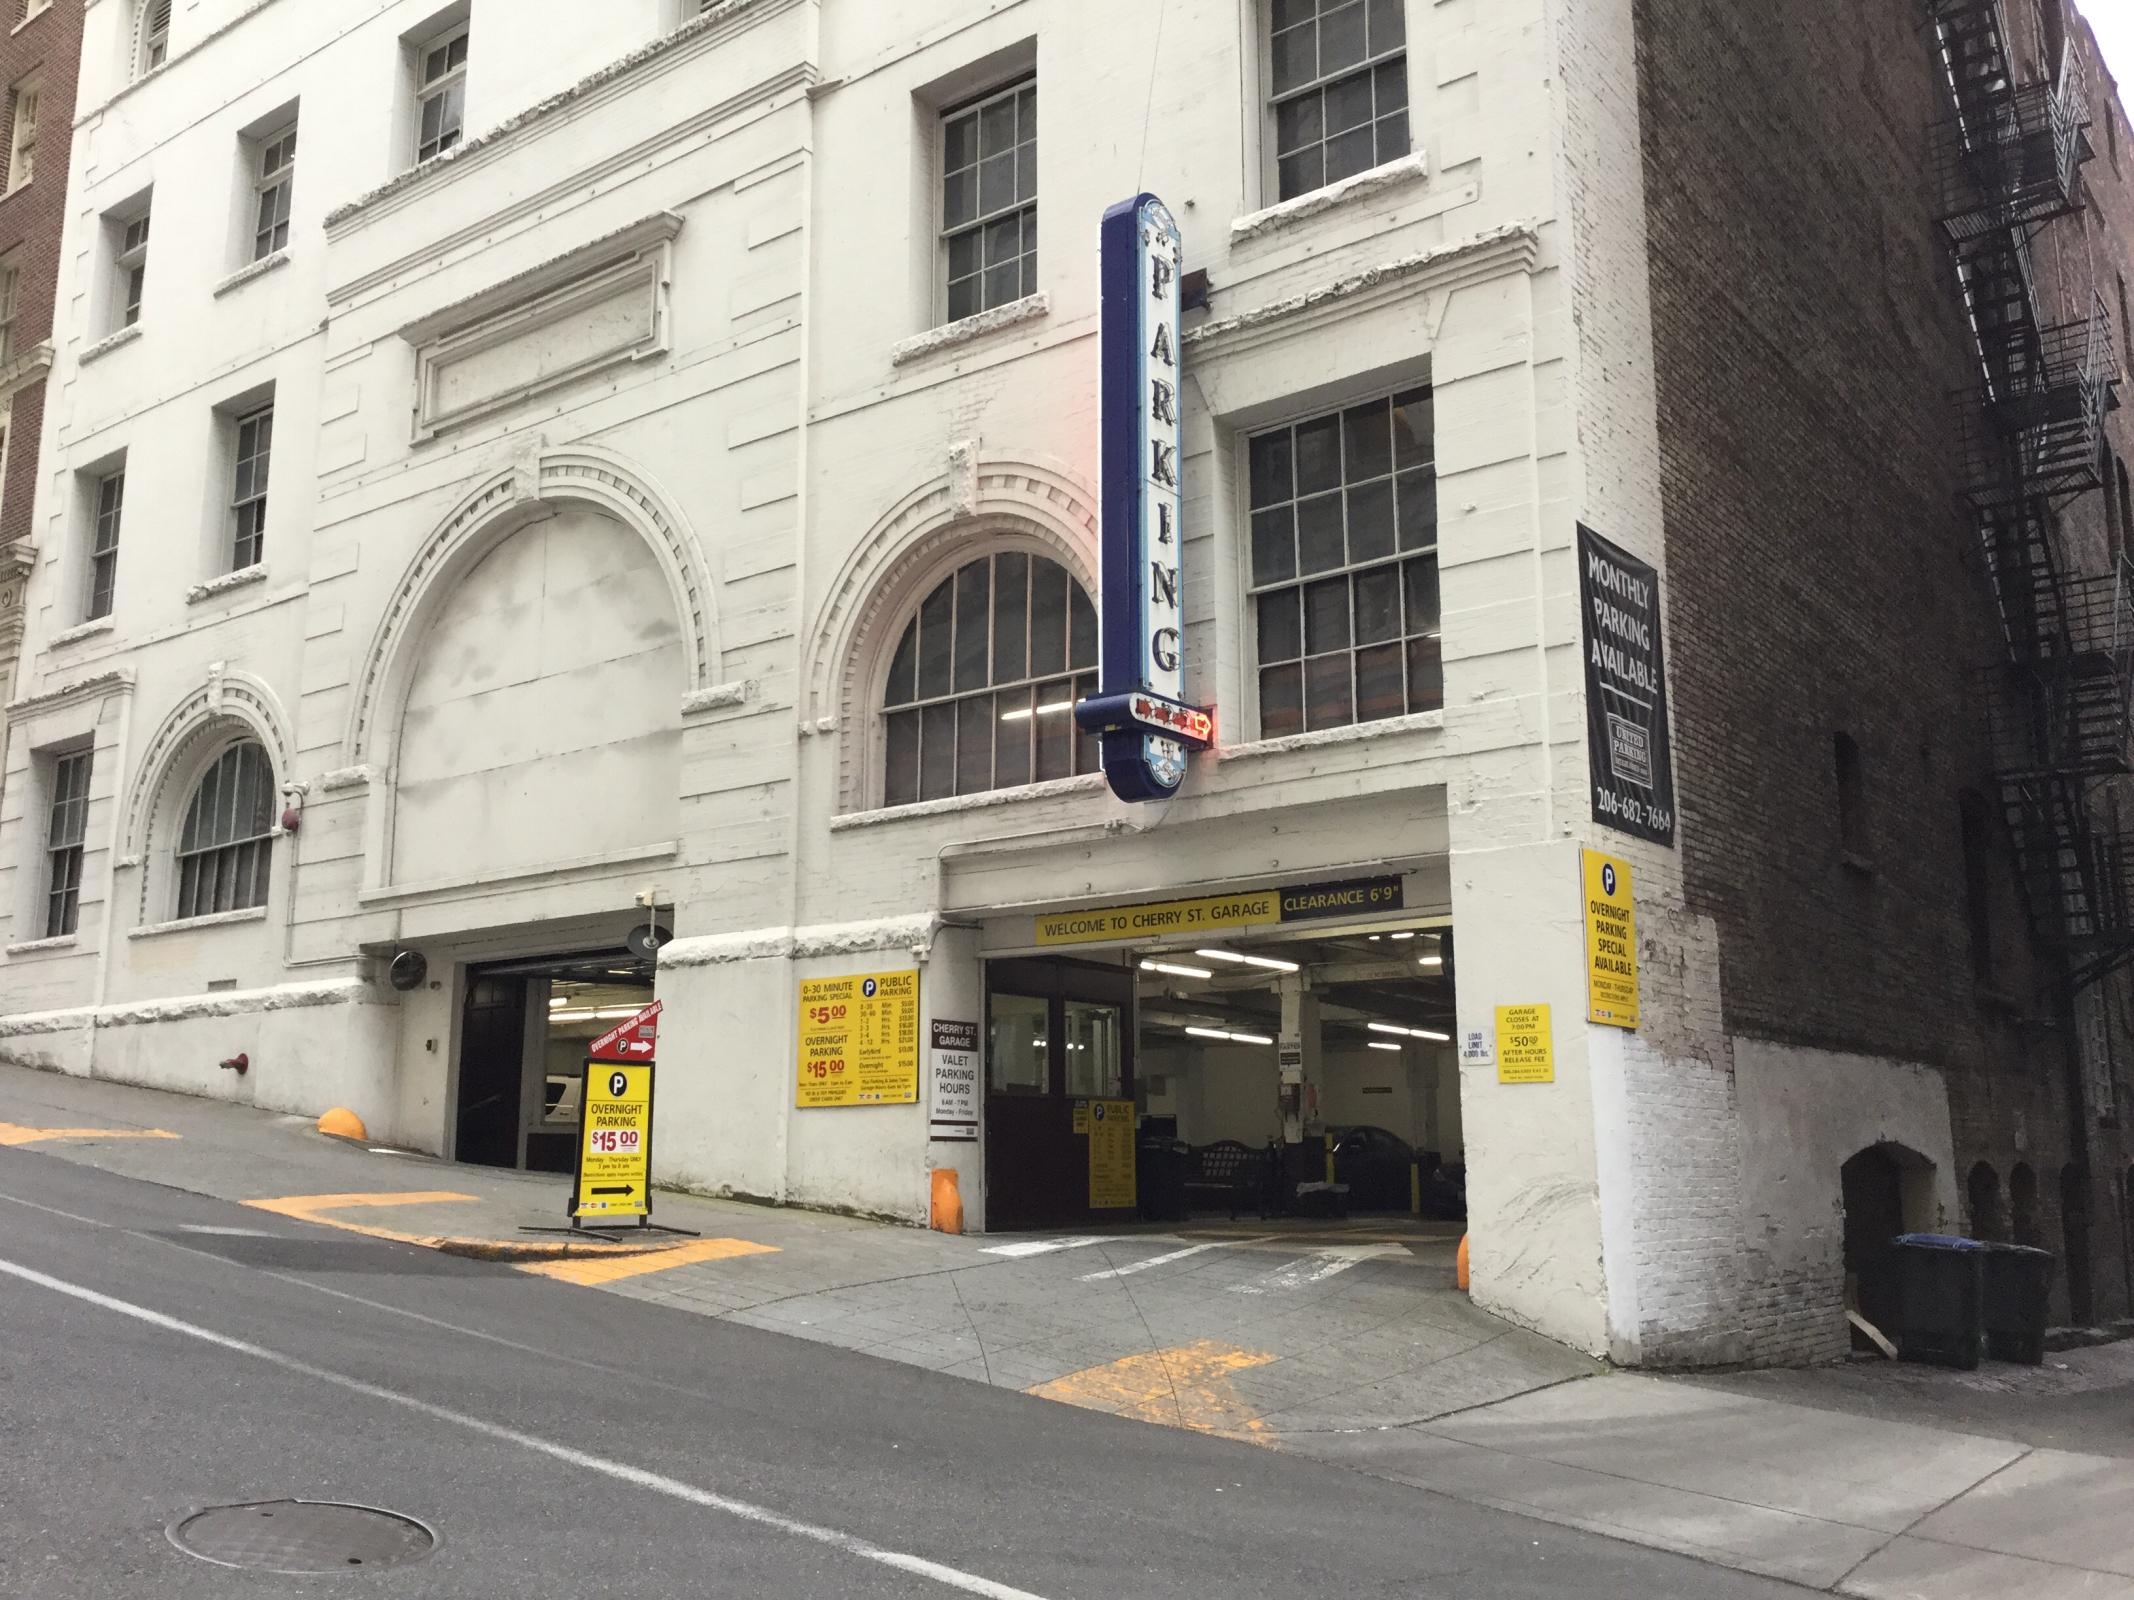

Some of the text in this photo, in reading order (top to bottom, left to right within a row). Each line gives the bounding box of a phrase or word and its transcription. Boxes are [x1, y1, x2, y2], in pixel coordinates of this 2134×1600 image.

[1149, 253, 1182, 673] PARKING
[1588, 552, 1649, 609] MONTHLY
[1594, 597, 1650, 651] PARKING
[1592, 638, 1657, 695] AVAILABLE
[1614, 740, 1647, 763] PARKING
[1597, 786, 1671, 832] 206-682-7664
[1284, 889, 1364, 912] CLEARANCE
[1590, 900, 1630, 923] OVERNIGHT
[1045, 901, 1270, 937] WELCOME TO CHERRY ST. GARAGE
[1596, 920, 1627, 940] PARKING
[1598, 938, 1627, 957] SPECIAL
[1595, 955, 1632, 976] AVAILABLE
[824, 981, 853, 992] MINUTE
[880, 975, 913, 987] PUBLIC
[803, 992, 853, 1002] PARKING SPECIAL
[880, 987, 912, 997] PARKING
[591, 1030, 618, 1053] OVERNIGHT
[618, 1017, 639, 1036] PARKING
[933, 1022, 964, 1035] CHERRY
[805, 1034, 848, 1046] OVERNIGHT
[939, 1035, 971, 1048] GARAGE
[1468, 1033, 1482, 1041] LOAD
[810, 1046, 843, 1057] PARKING
[1468, 1041, 1482, 1049] LIMIT
[942, 1054, 969, 1066] VALET
[936, 1068, 974, 1080] PARKING
[940, 1082, 970, 1095] HOURS
[591, 1103, 642, 1115] OVERNIGHT
[597, 1116, 636, 1127] PARKING
